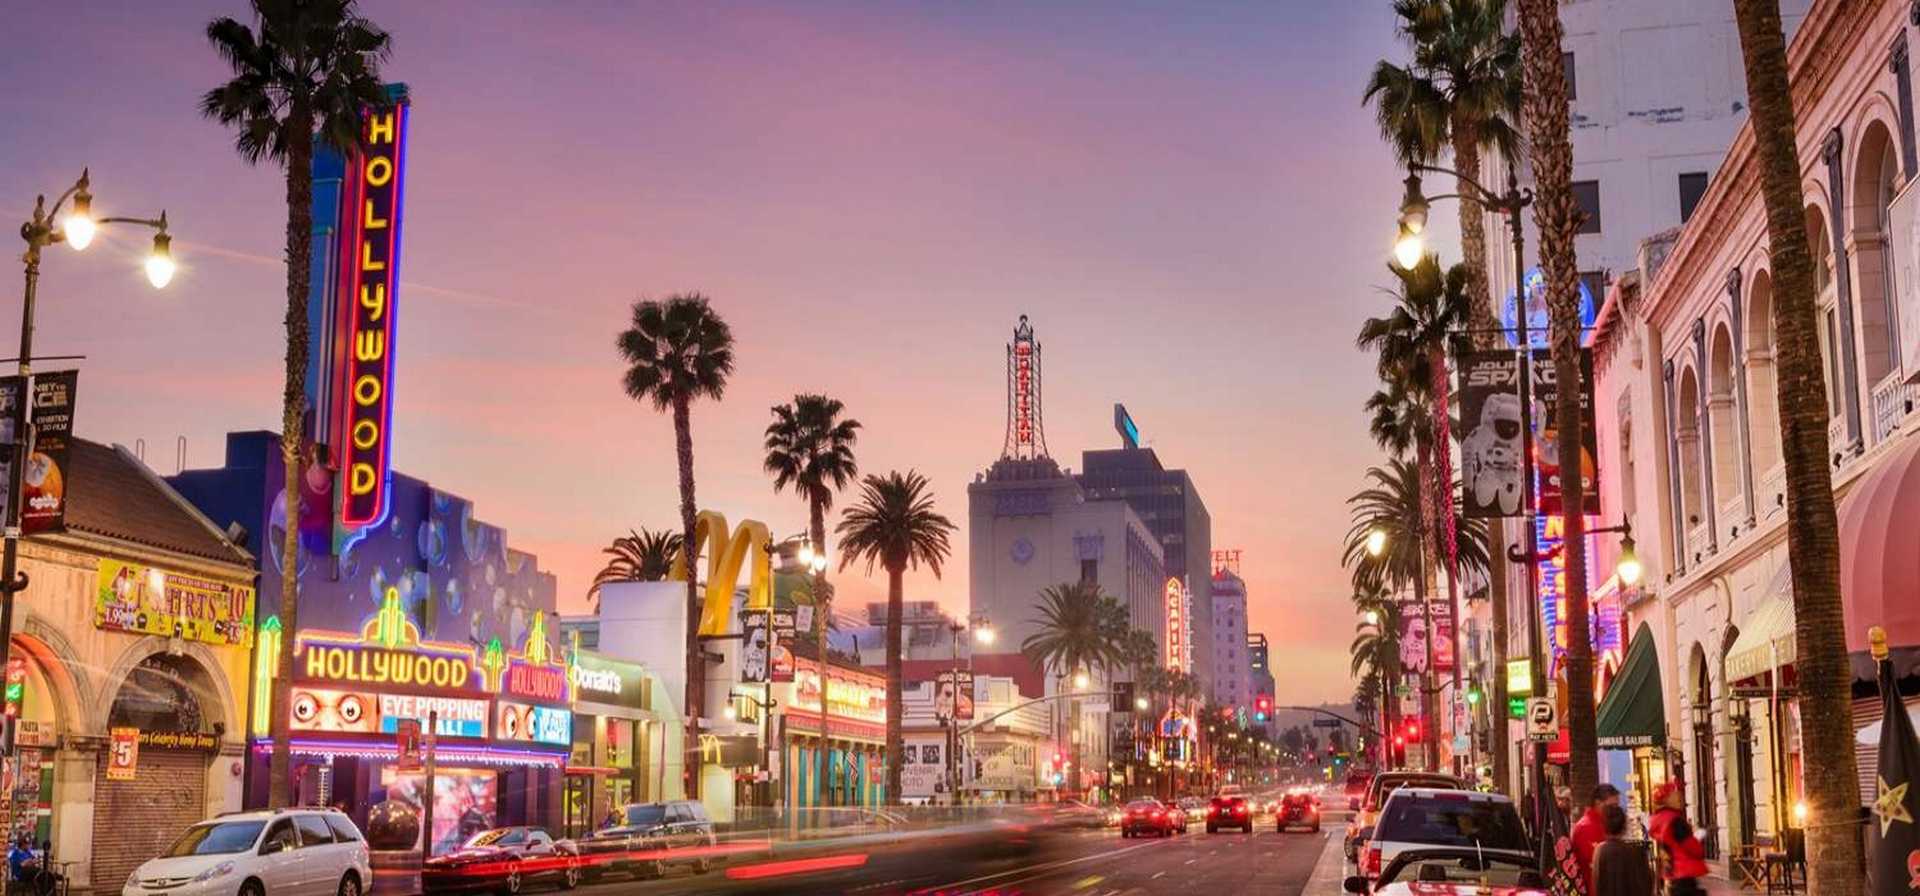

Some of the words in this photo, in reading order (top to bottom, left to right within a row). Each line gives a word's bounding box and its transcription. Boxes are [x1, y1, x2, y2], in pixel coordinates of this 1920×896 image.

[351, 113, 394, 495] HOLLYWOOD
[1467, 367, 1584, 387] SPAC
[307, 646, 467, 687] HOLLYWOOD
[511, 666, 563, 699] HOLLYWOOD
[383, 698, 414, 718] EYE
[415, 698, 482, 720] POPPING
